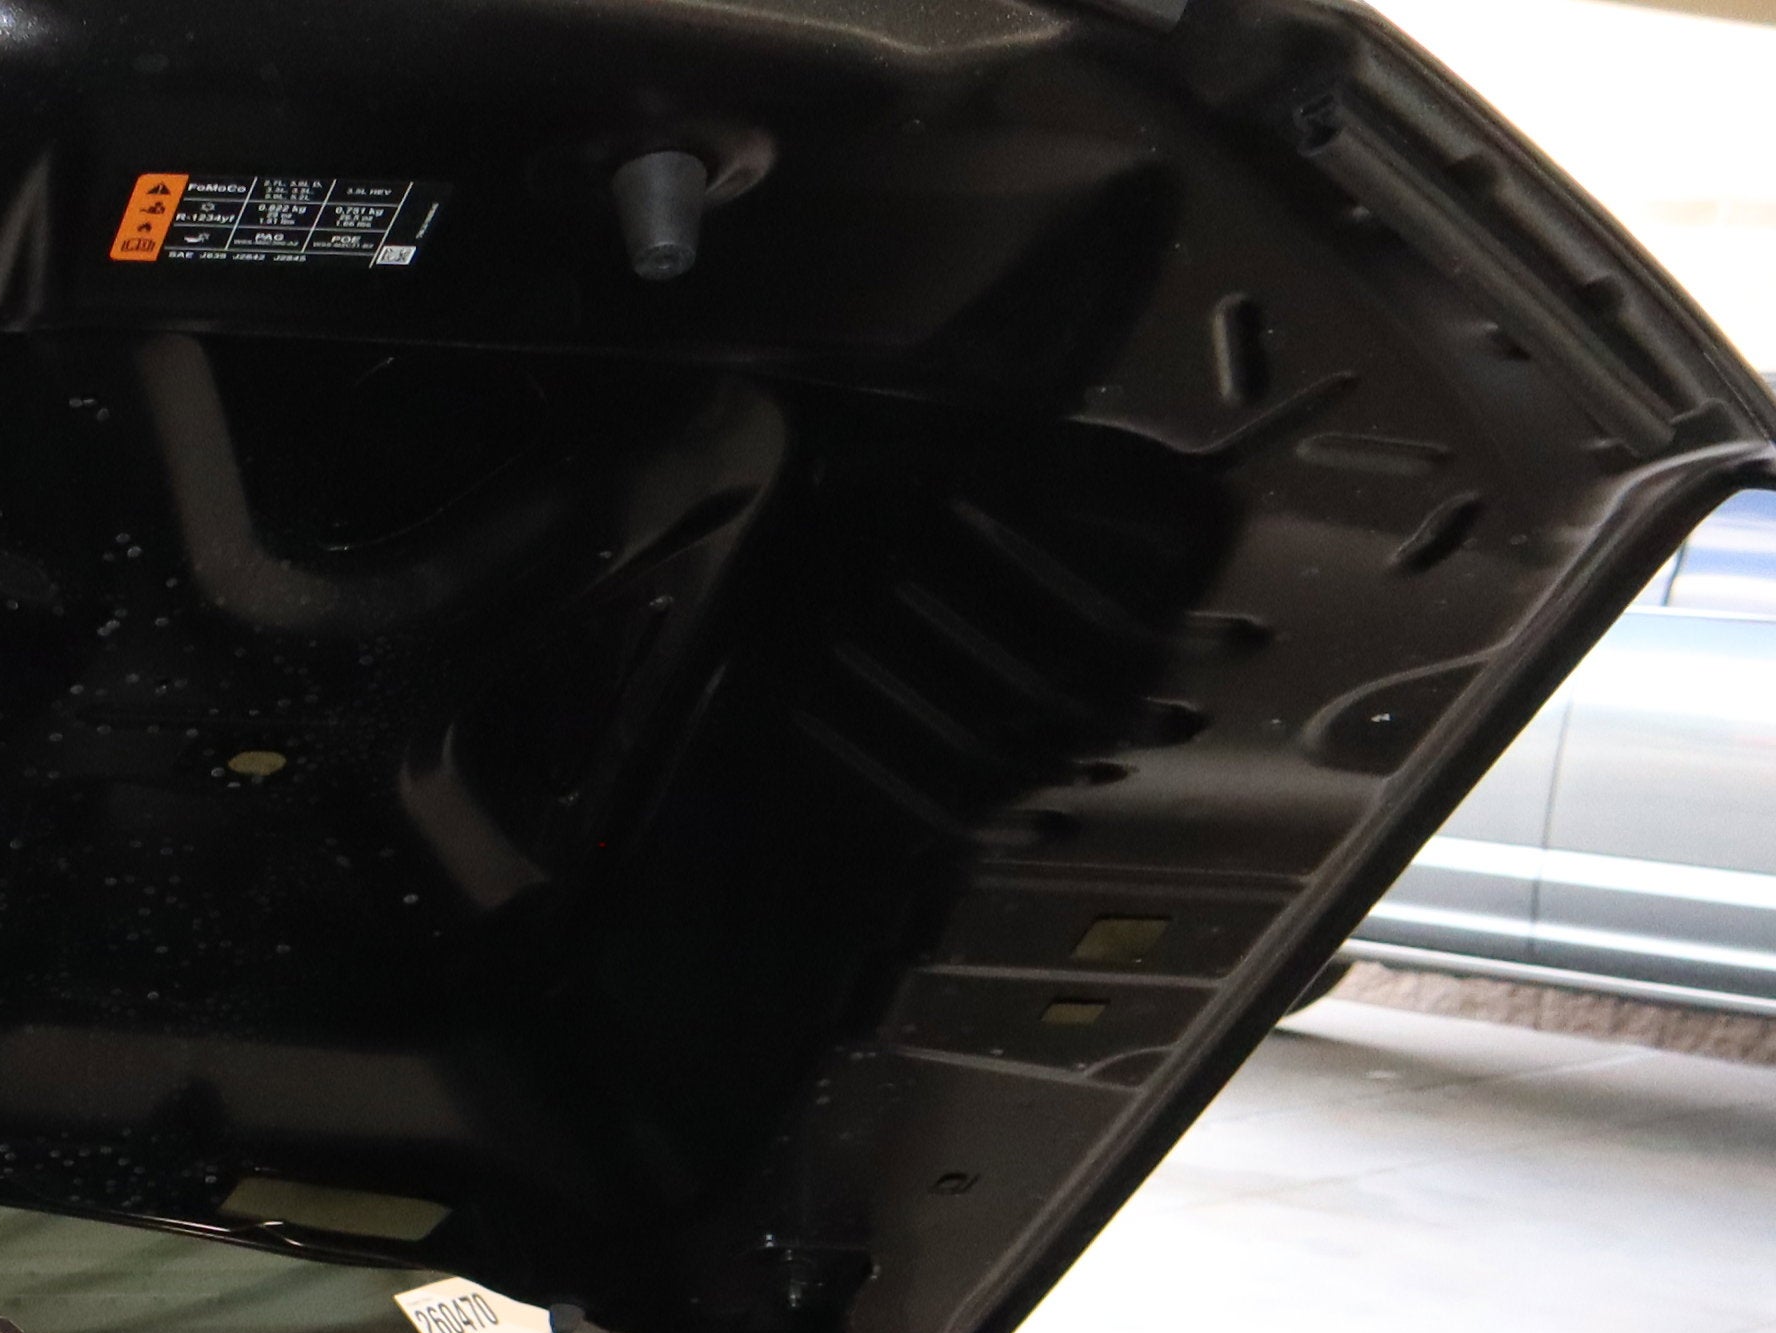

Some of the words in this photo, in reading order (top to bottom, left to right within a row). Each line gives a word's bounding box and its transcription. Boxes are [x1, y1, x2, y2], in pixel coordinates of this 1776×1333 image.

[187, 183, 247, 193] FoMoCo
[176, 213, 236, 224] R-1234yf
[255, 233, 285, 242] PAG
[331, 236, 362, 244] POE
[168, 251, 195, 259] SAE
